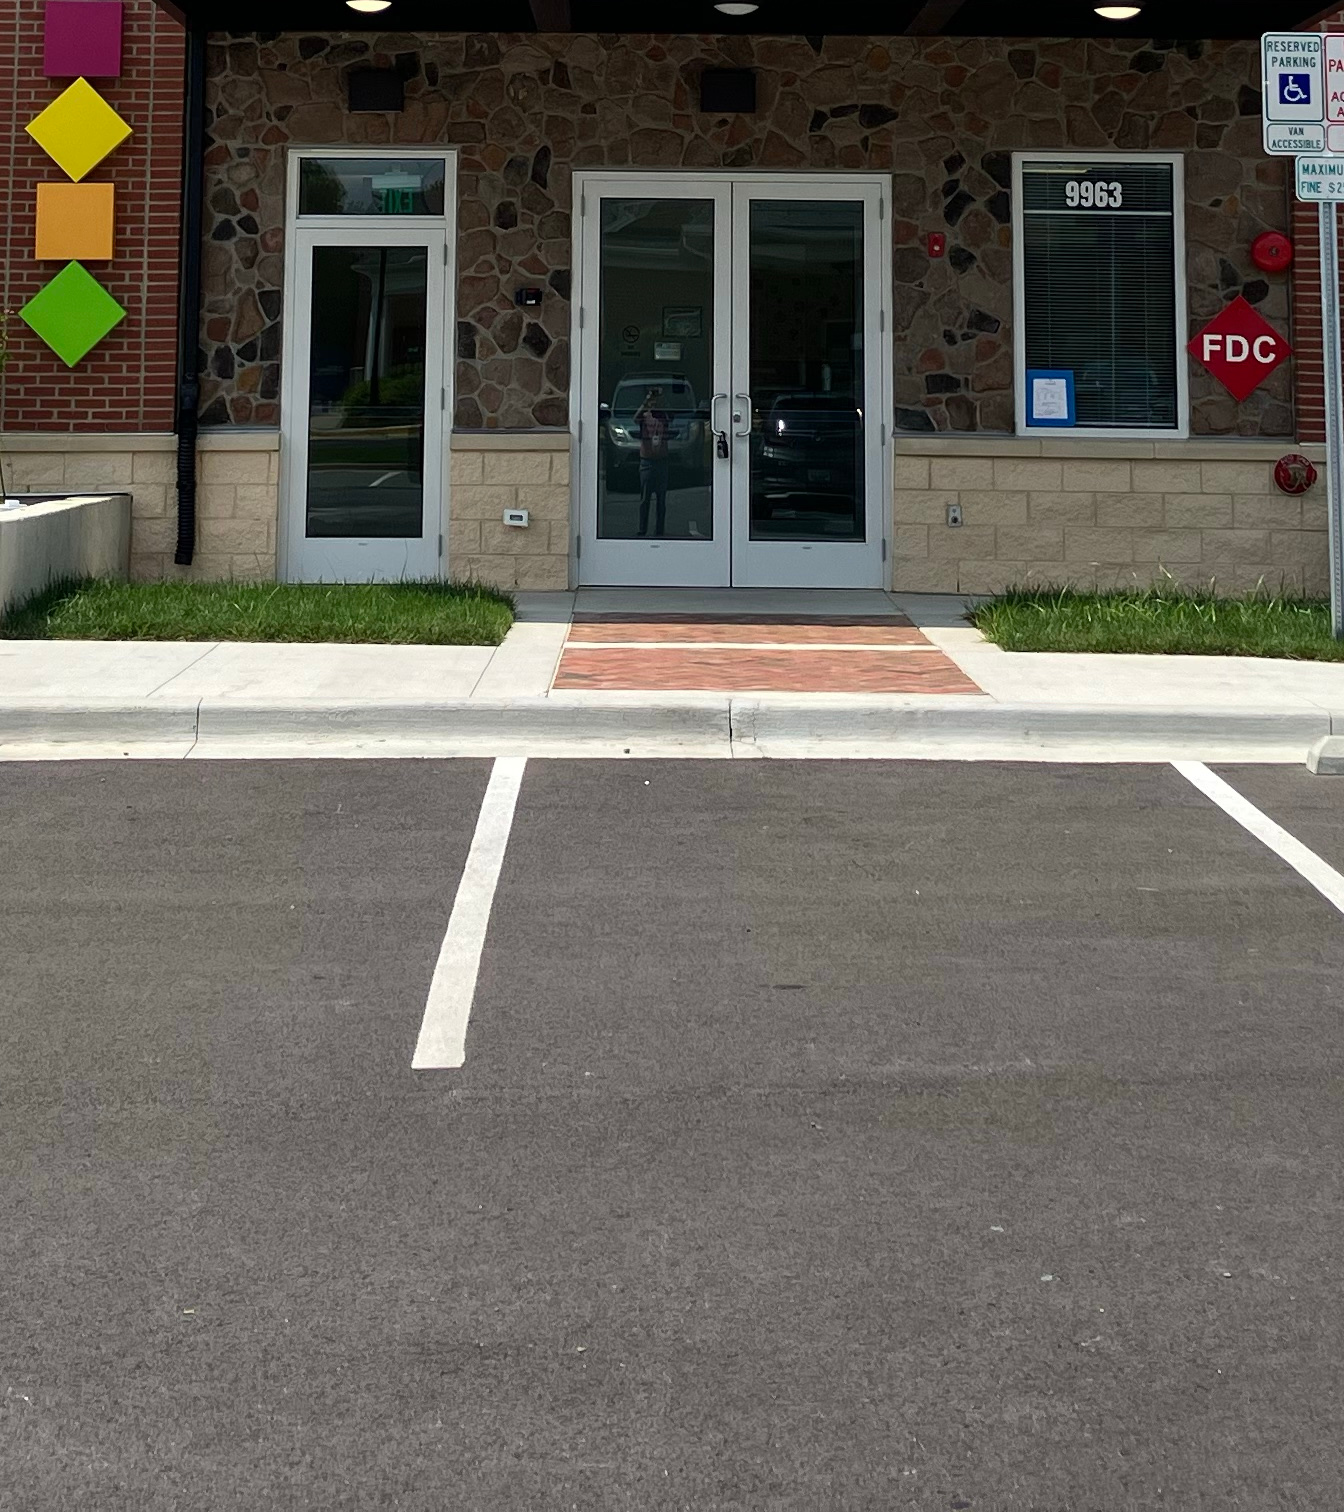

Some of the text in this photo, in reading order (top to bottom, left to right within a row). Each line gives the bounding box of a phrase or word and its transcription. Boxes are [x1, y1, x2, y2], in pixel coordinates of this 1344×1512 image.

[1267, 41, 1320, 53] RESERVED
[1271, 57, 1316, 68] PARKING
[1288, 127, 1304, 136] VAN
[1271, 140, 1321, 149] ACCESSIBLE
[1301, 181, 1322, 194] FINE
[1065, 181, 1123, 208] 9963
[1202, 334, 1276, 365] FDC
